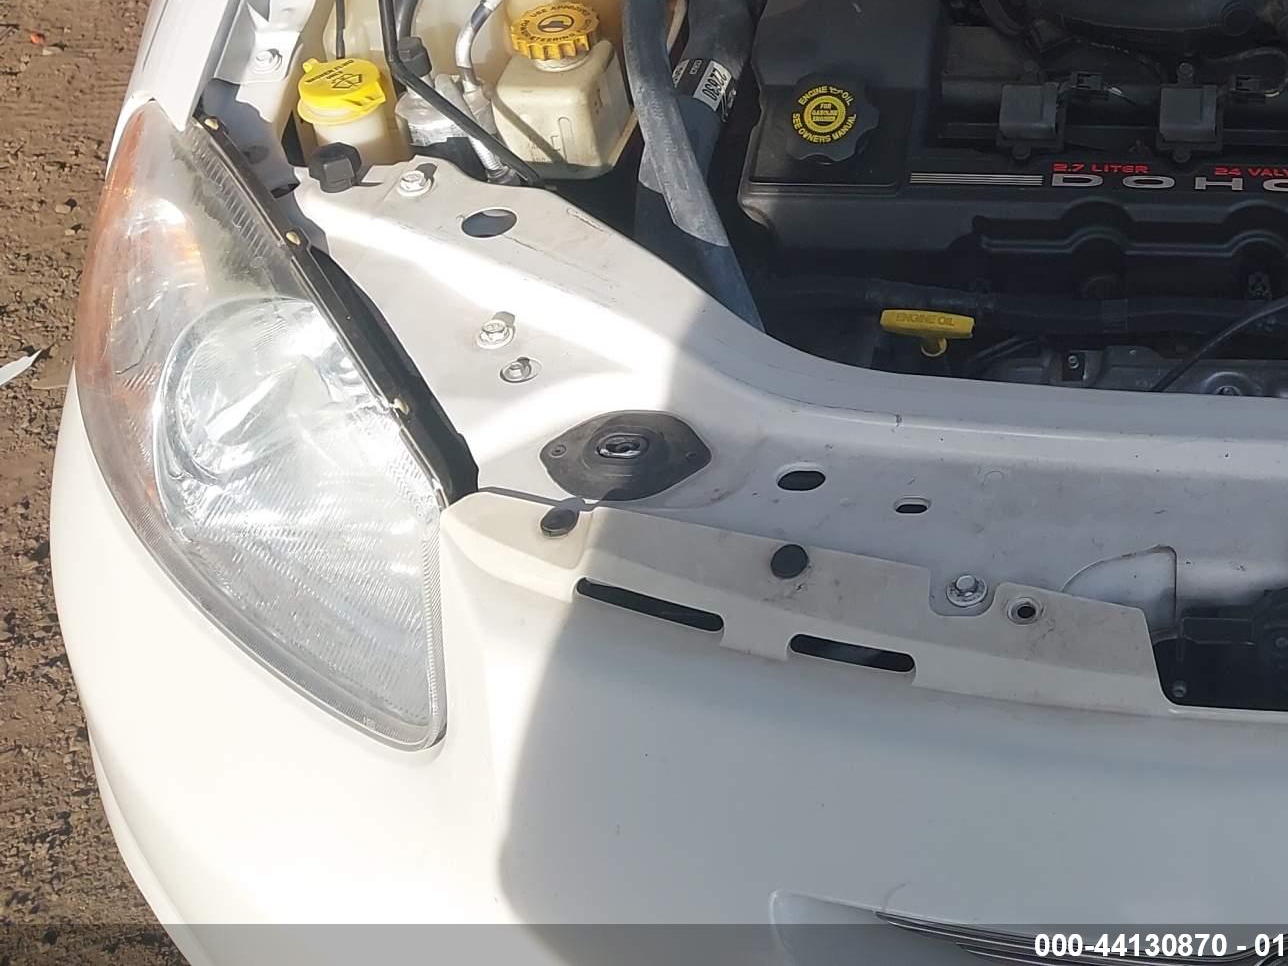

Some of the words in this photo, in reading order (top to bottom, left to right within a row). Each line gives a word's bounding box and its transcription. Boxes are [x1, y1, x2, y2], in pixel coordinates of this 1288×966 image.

[798, 85, 828, 105] ENGINE
[841, 92, 854, 106] OIL
[792, 113, 803, 130] SEE
[832, 114, 857, 140] MANUAL
[1053, 163, 1085, 172] 2.7
[1091, 164, 1149, 174] LITER
[1215, 167, 1241, 176] 24
[895, 313, 938, 324] ENGINE
[938, 316, 955, 327] OIL
